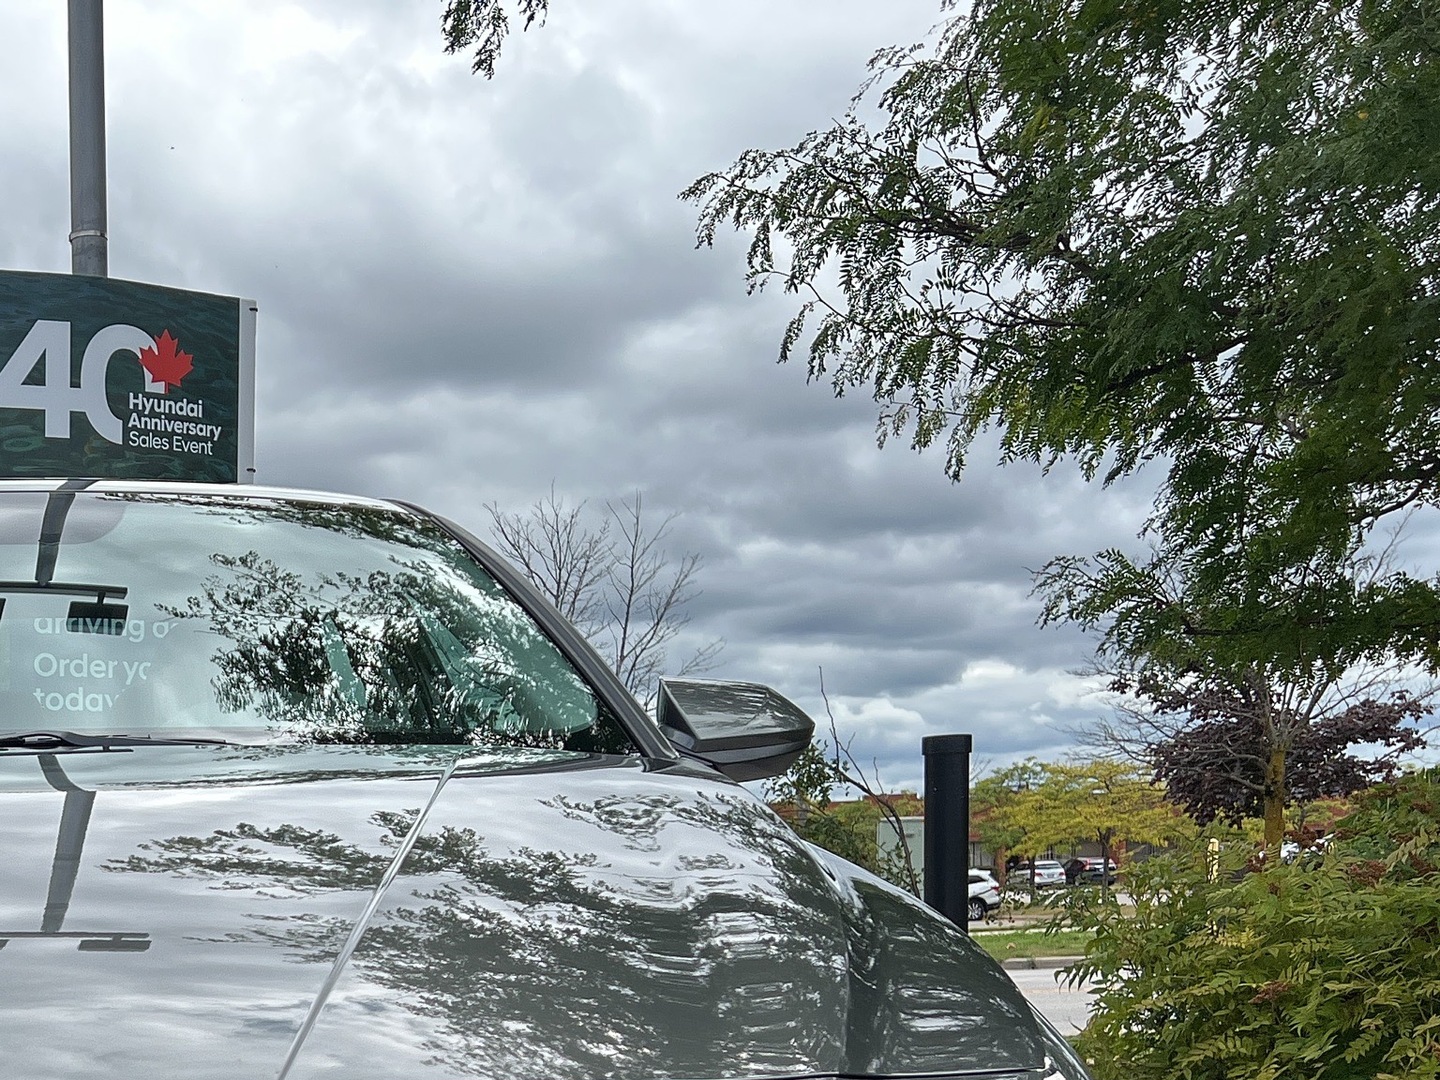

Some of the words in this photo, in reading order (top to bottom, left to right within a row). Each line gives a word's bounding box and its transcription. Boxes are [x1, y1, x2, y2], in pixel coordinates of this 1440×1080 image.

[128, 392, 203, 418] Hyundai
[127, 412, 222, 441] Anniversary
[128, 430, 170, 450] Sales
[173, 435, 213, 456] Event
[33, 652, 118, 679] Order
